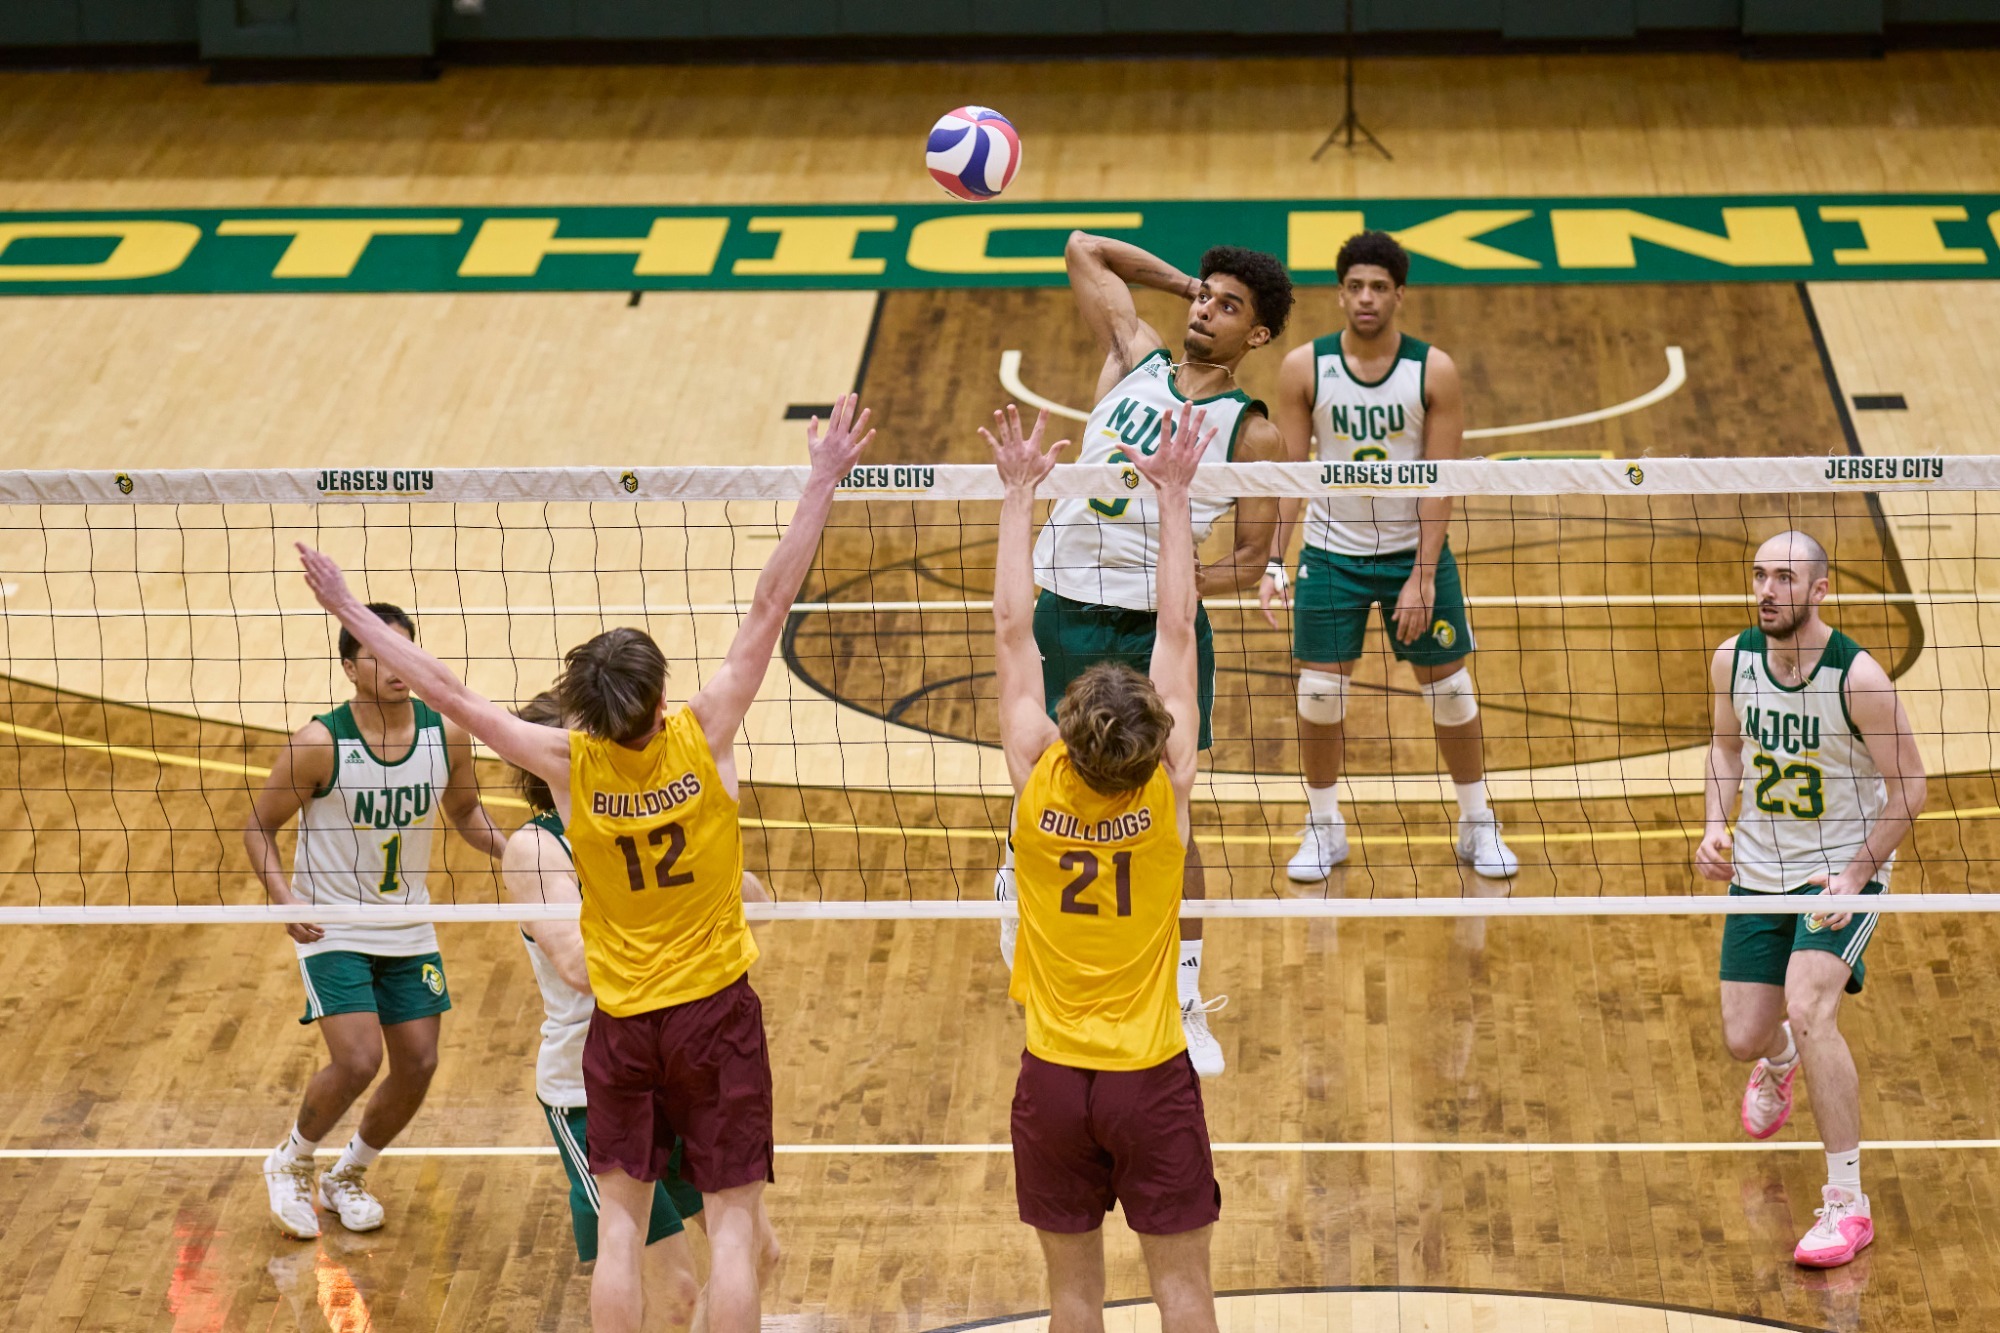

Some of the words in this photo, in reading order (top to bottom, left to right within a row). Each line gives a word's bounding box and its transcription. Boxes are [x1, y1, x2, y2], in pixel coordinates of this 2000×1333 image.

[1287, 205, 2000, 271] KNI
[1105, 397, 1200, 457] NJC
[1331, 403, 1405, 441] NJCU
[316, 470, 388, 491] JERSEY
[393, 470, 434, 491] CITY
[836, 467, 889, 488] RSEY
[894, 467, 935, 488] CITY
[1320, 464, 1393, 485] JERSEY
[1398, 463, 1438, 484] CITY
[1825, 458, 1897, 479] JERSEY
[1902, 458, 1943, 478] CITY
[1745, 705, 1820, 754] NJCU
[354, 782, 431, 830] NJCU
[592, 771, 701, 818] BULLDOGS
[1752, 752, 1826, 819] 23
[1039, 807, 1152, 843] BULLDOGS
[379, 834, 400, 894] 1
[614, 821, 695, 892] 12
[1059, 850, 1133, 917] 21
